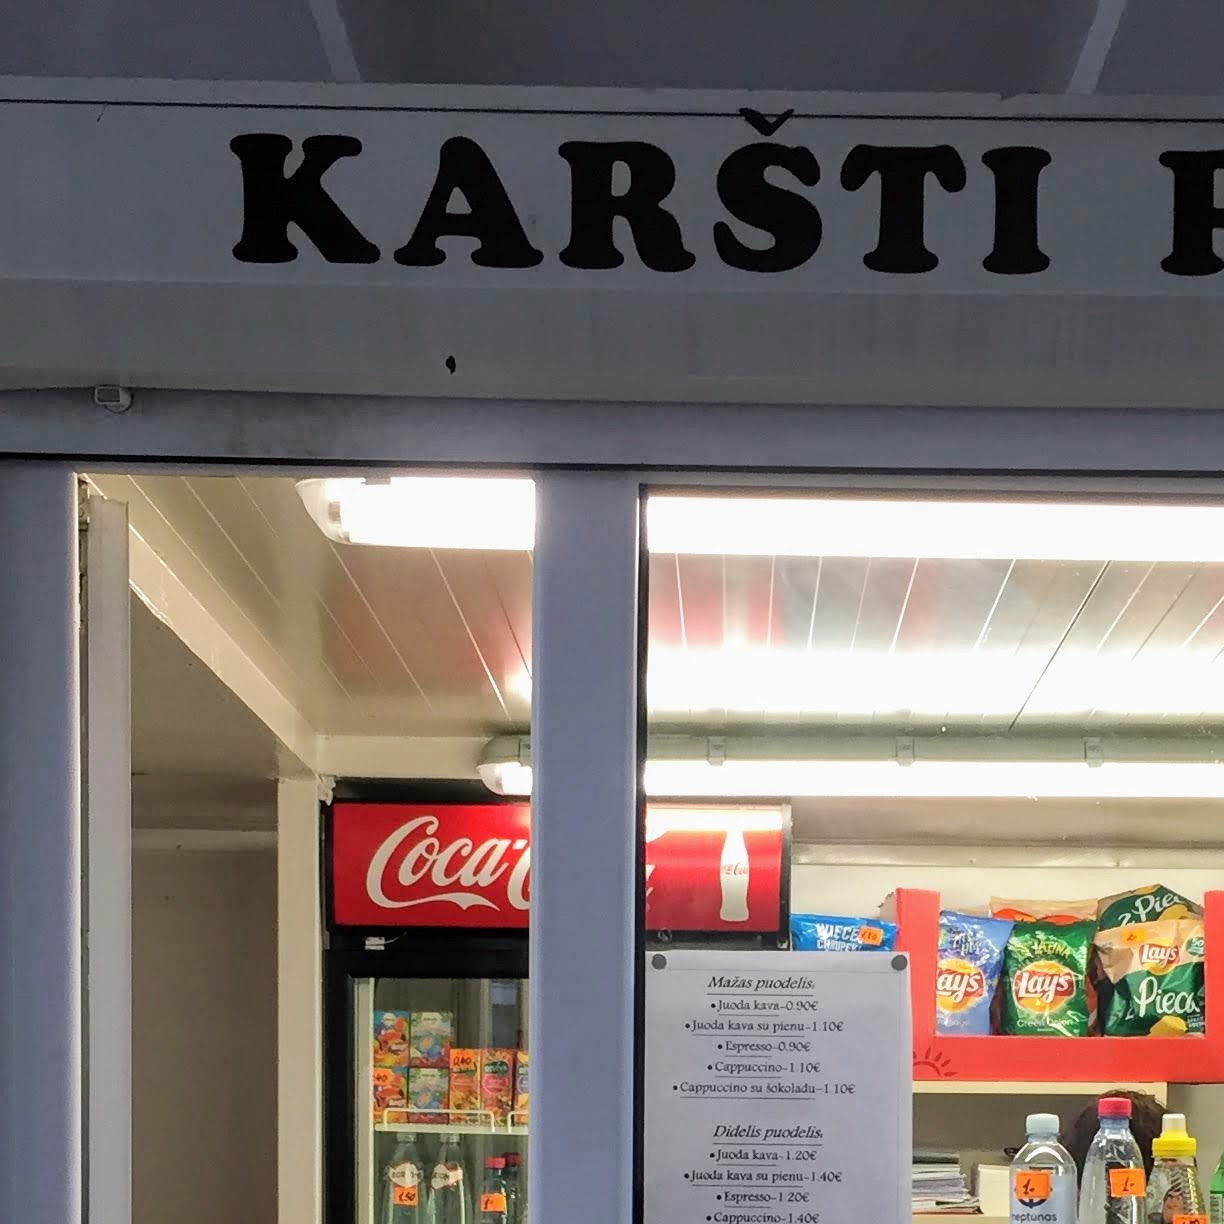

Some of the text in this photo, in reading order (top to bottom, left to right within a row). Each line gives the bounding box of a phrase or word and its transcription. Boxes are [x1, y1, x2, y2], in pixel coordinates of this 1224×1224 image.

[229, 108, 1051, 275] KARŠTI
[707, 976, 752, 989] Mažas
[718, 1001, 750, 1012] Juoda
[691, 1021, 724, 1032] Juoda
[728, 1021, 754, 1032] kava
[757, 1023, 769, 1031] su
[680, 1082, 747, 1095] Cappuccino
[750, 1084, 762, 1093] su
[713, 1125, 761, 1138] Didelis
[716, 1149, 749, 1161] Juoda
[690, 1169, 723, 1182] Juoda
[726, 1170, 753, 1181] kava
[756, 1172, 768, 1181] su
